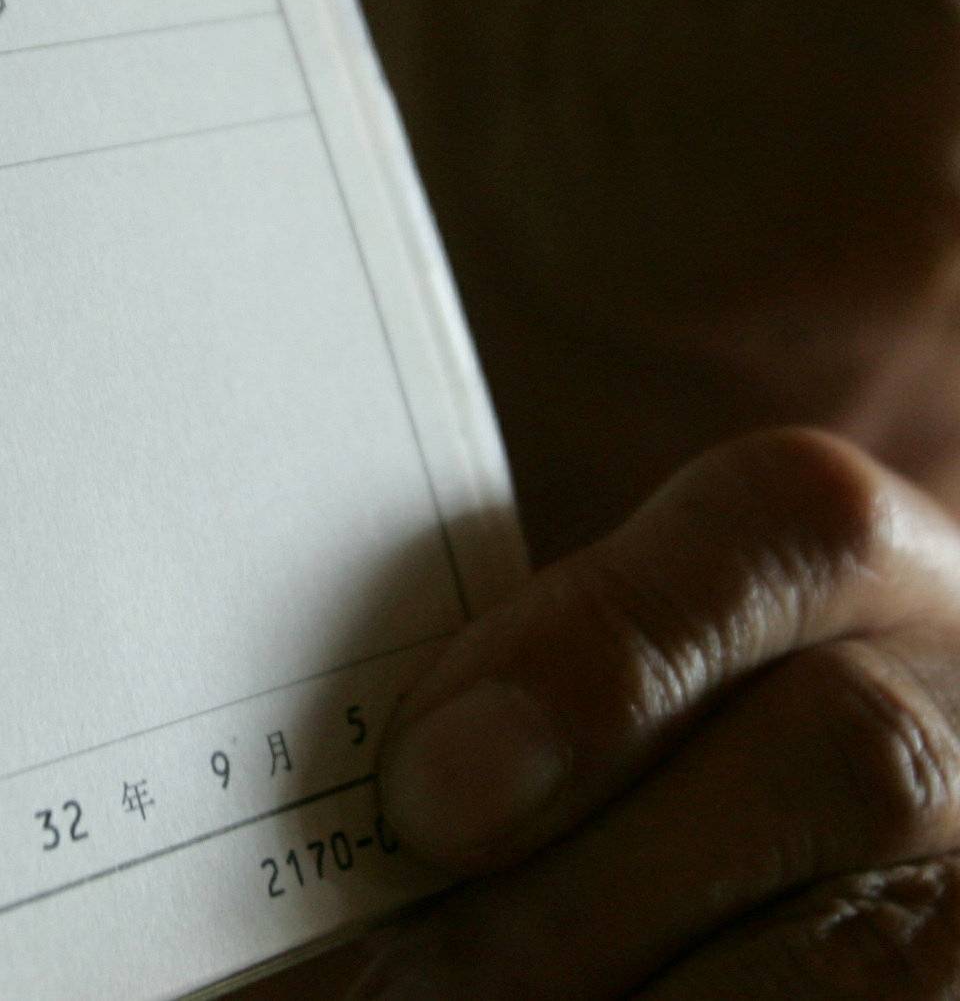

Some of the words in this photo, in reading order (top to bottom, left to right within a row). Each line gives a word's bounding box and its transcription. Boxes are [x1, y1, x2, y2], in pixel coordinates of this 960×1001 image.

[34, 798, 90, 852] 32
[120, 778, 157, 822] 年
[210, 750, 232, 791] 9
[265, 729, 293, 779] 月
[346, 703, 368, 747] 5
